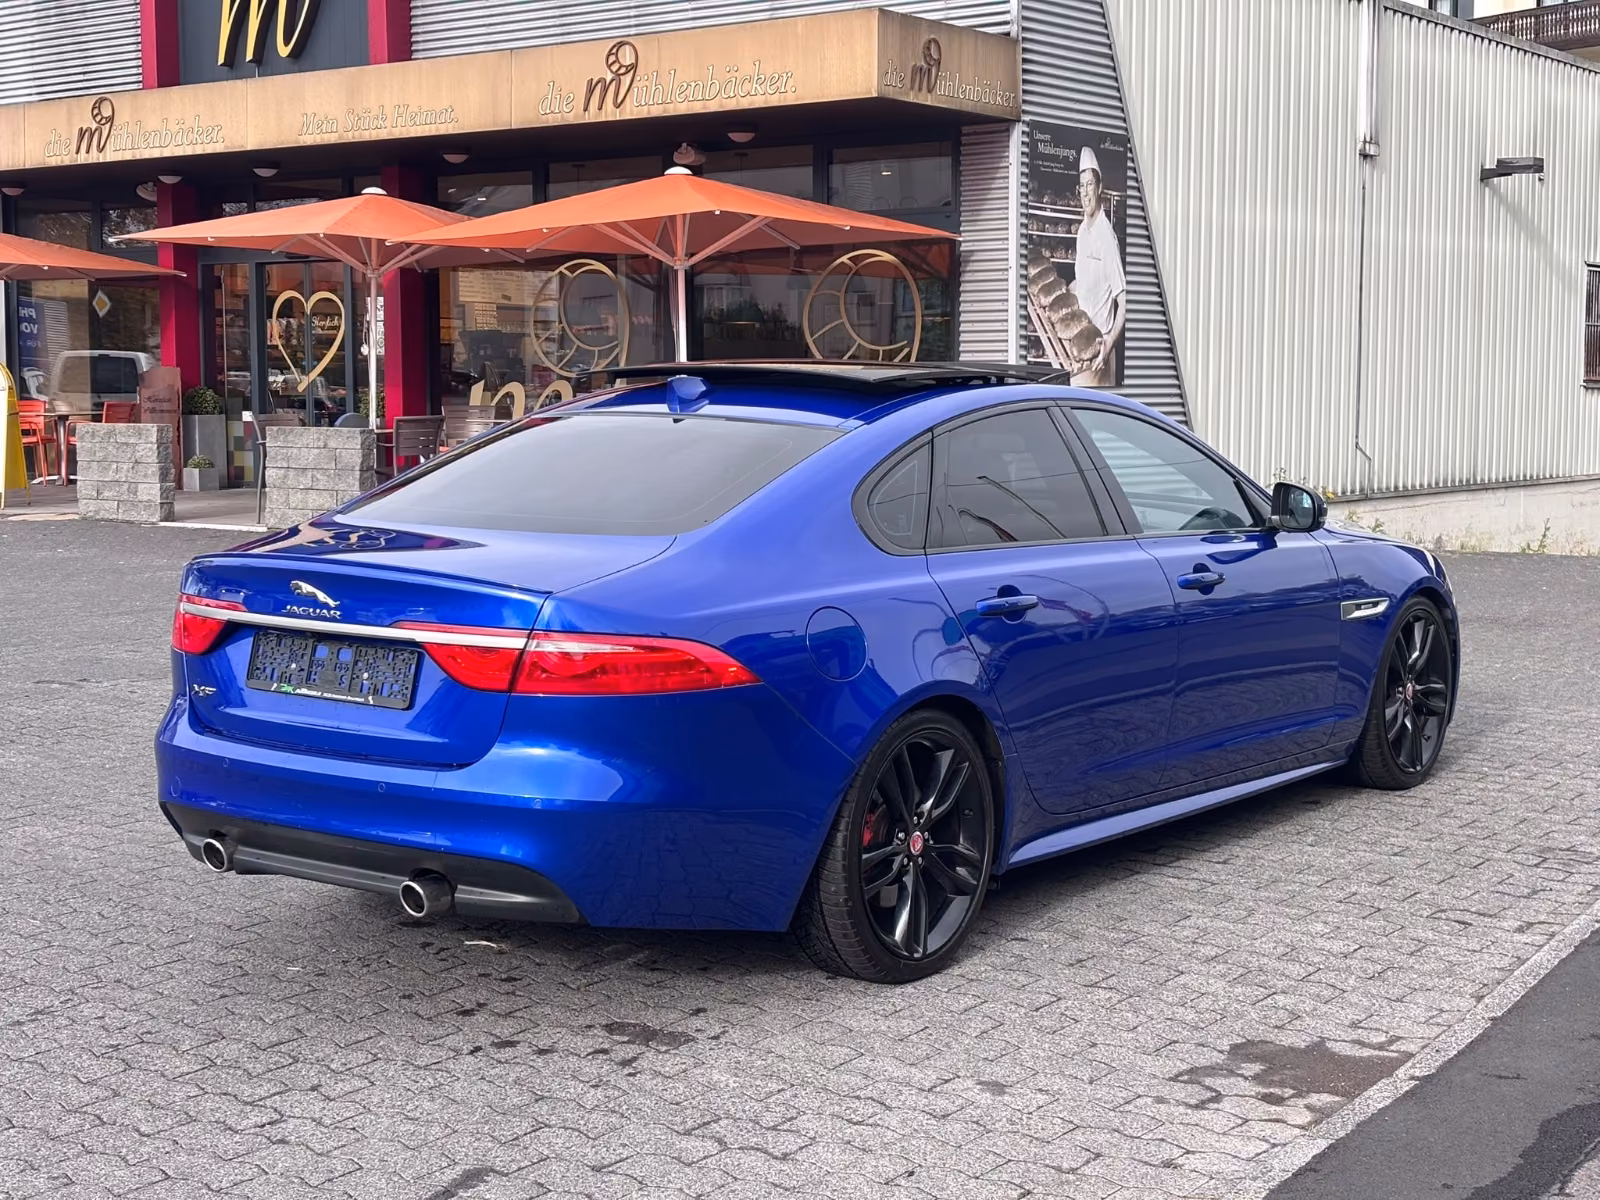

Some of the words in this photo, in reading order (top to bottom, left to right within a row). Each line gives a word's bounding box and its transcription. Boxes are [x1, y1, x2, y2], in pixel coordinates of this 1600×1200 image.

[883, 60, 905, 88] die
[538, 80, 575, 115] die
[298, 112, 338, 136] Mein
[344, 104, 387, 132] Stück
[391, 103, 459, 128] Heimat.
[44, 129, 71, 157] die
[1033, 130, 1051, 141] Unsere
[1037, 142, 1078, 161] Mühlenjungs.
[281, 604, 342, 619] JAGUAR
